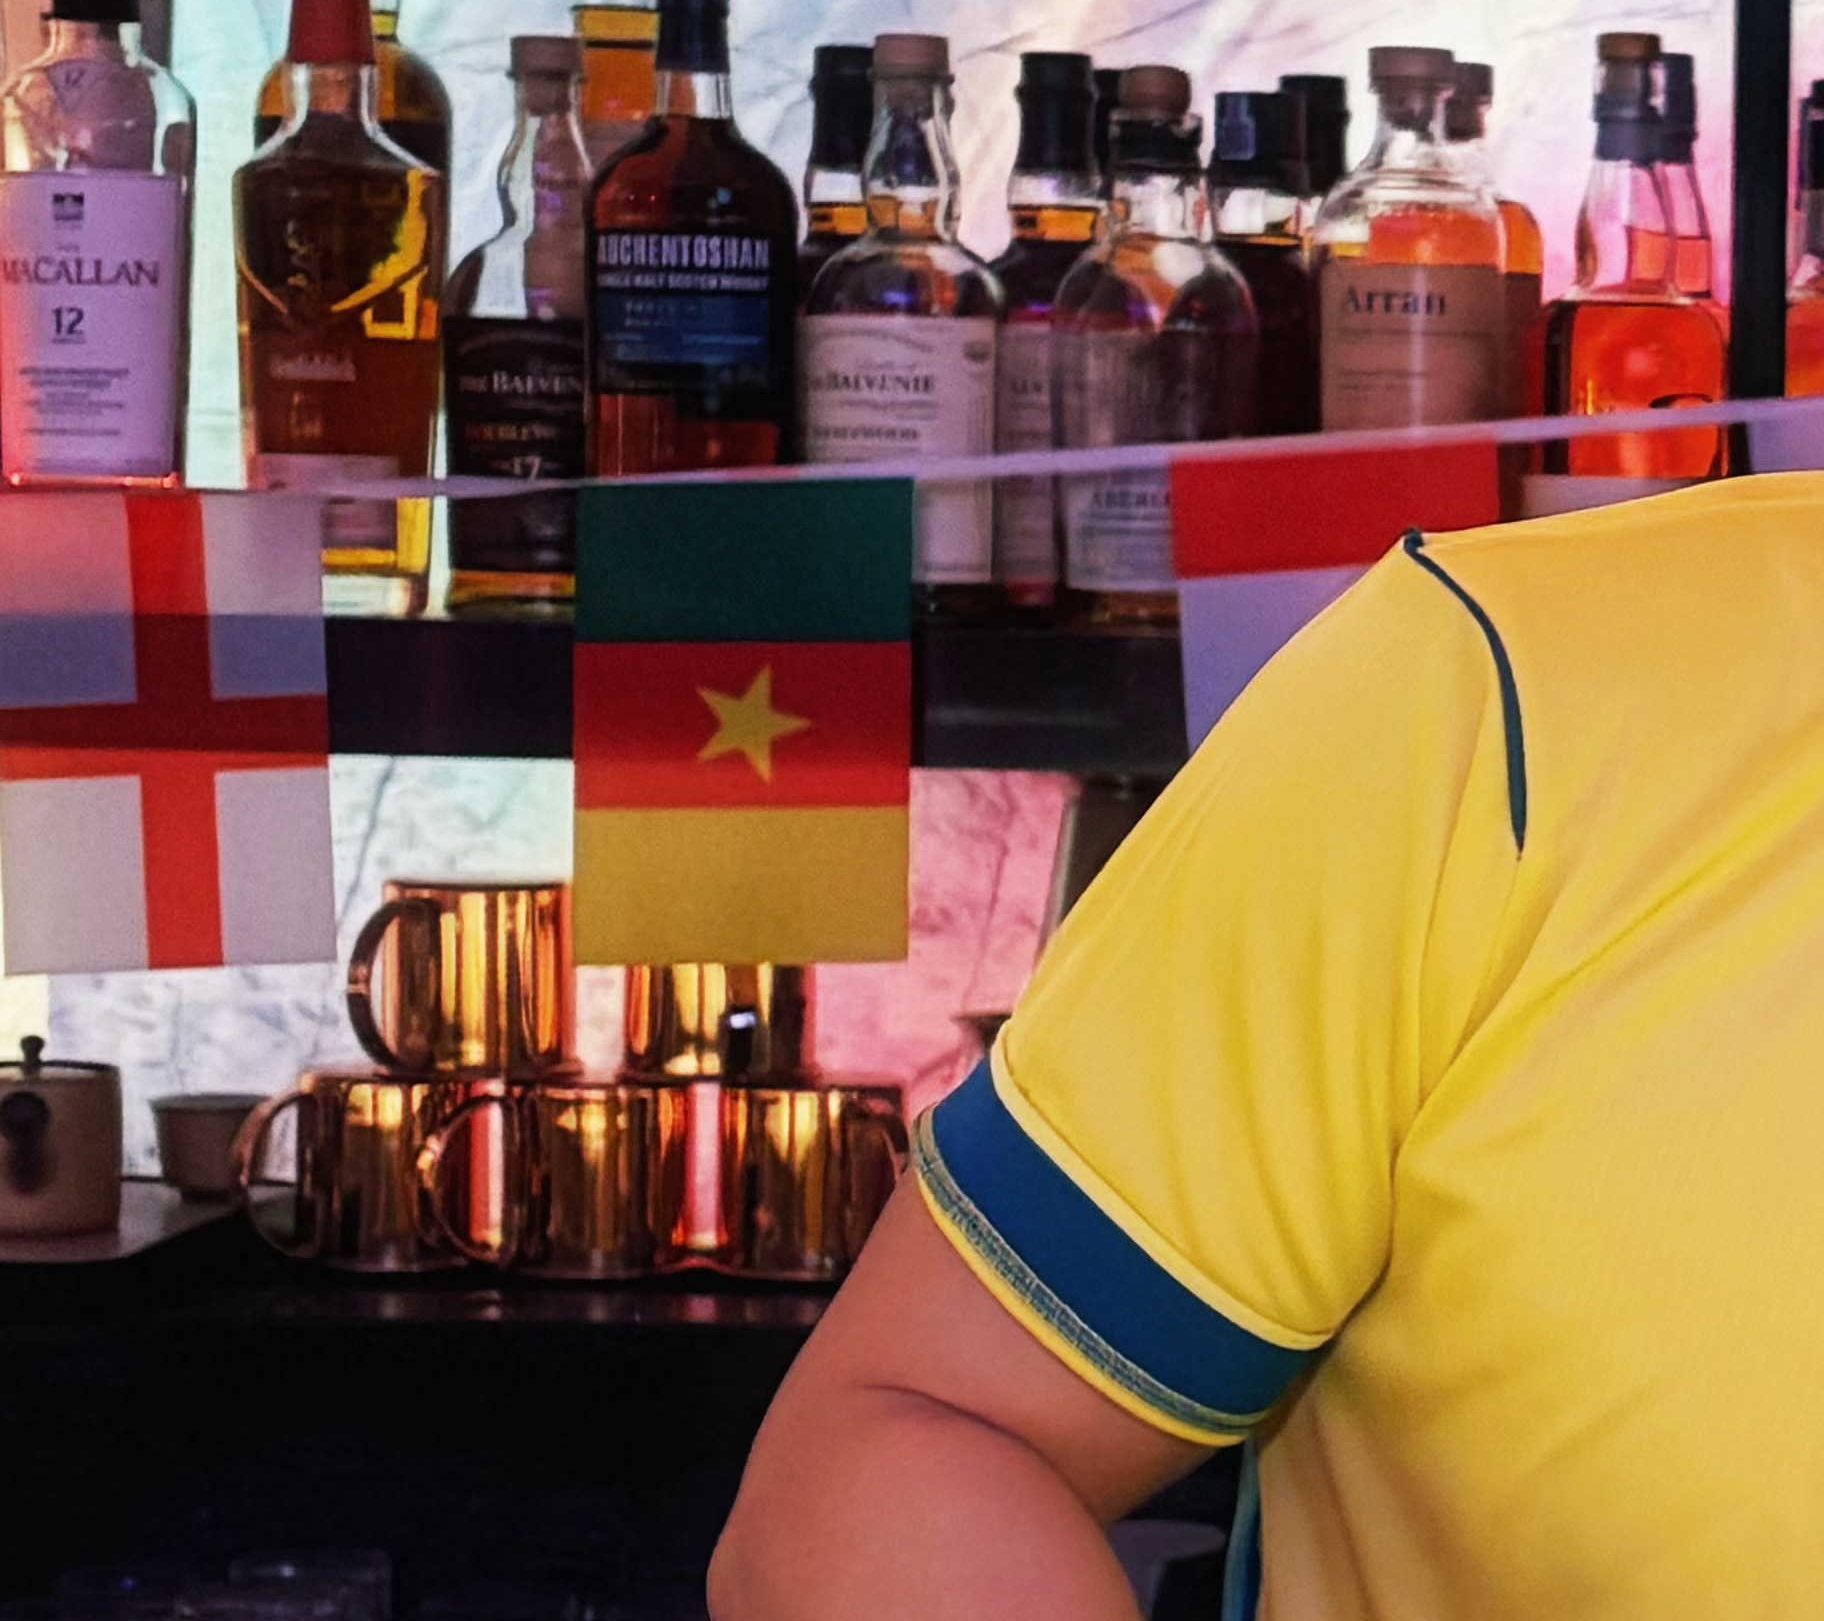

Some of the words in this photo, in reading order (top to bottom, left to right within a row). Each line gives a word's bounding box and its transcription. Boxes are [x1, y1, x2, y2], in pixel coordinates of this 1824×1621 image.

[597, 234, 770, 270] AUCHENTOSHAN
[1342, 284, 1446, 316] Arran
[52, 306, 85, 336] 12
